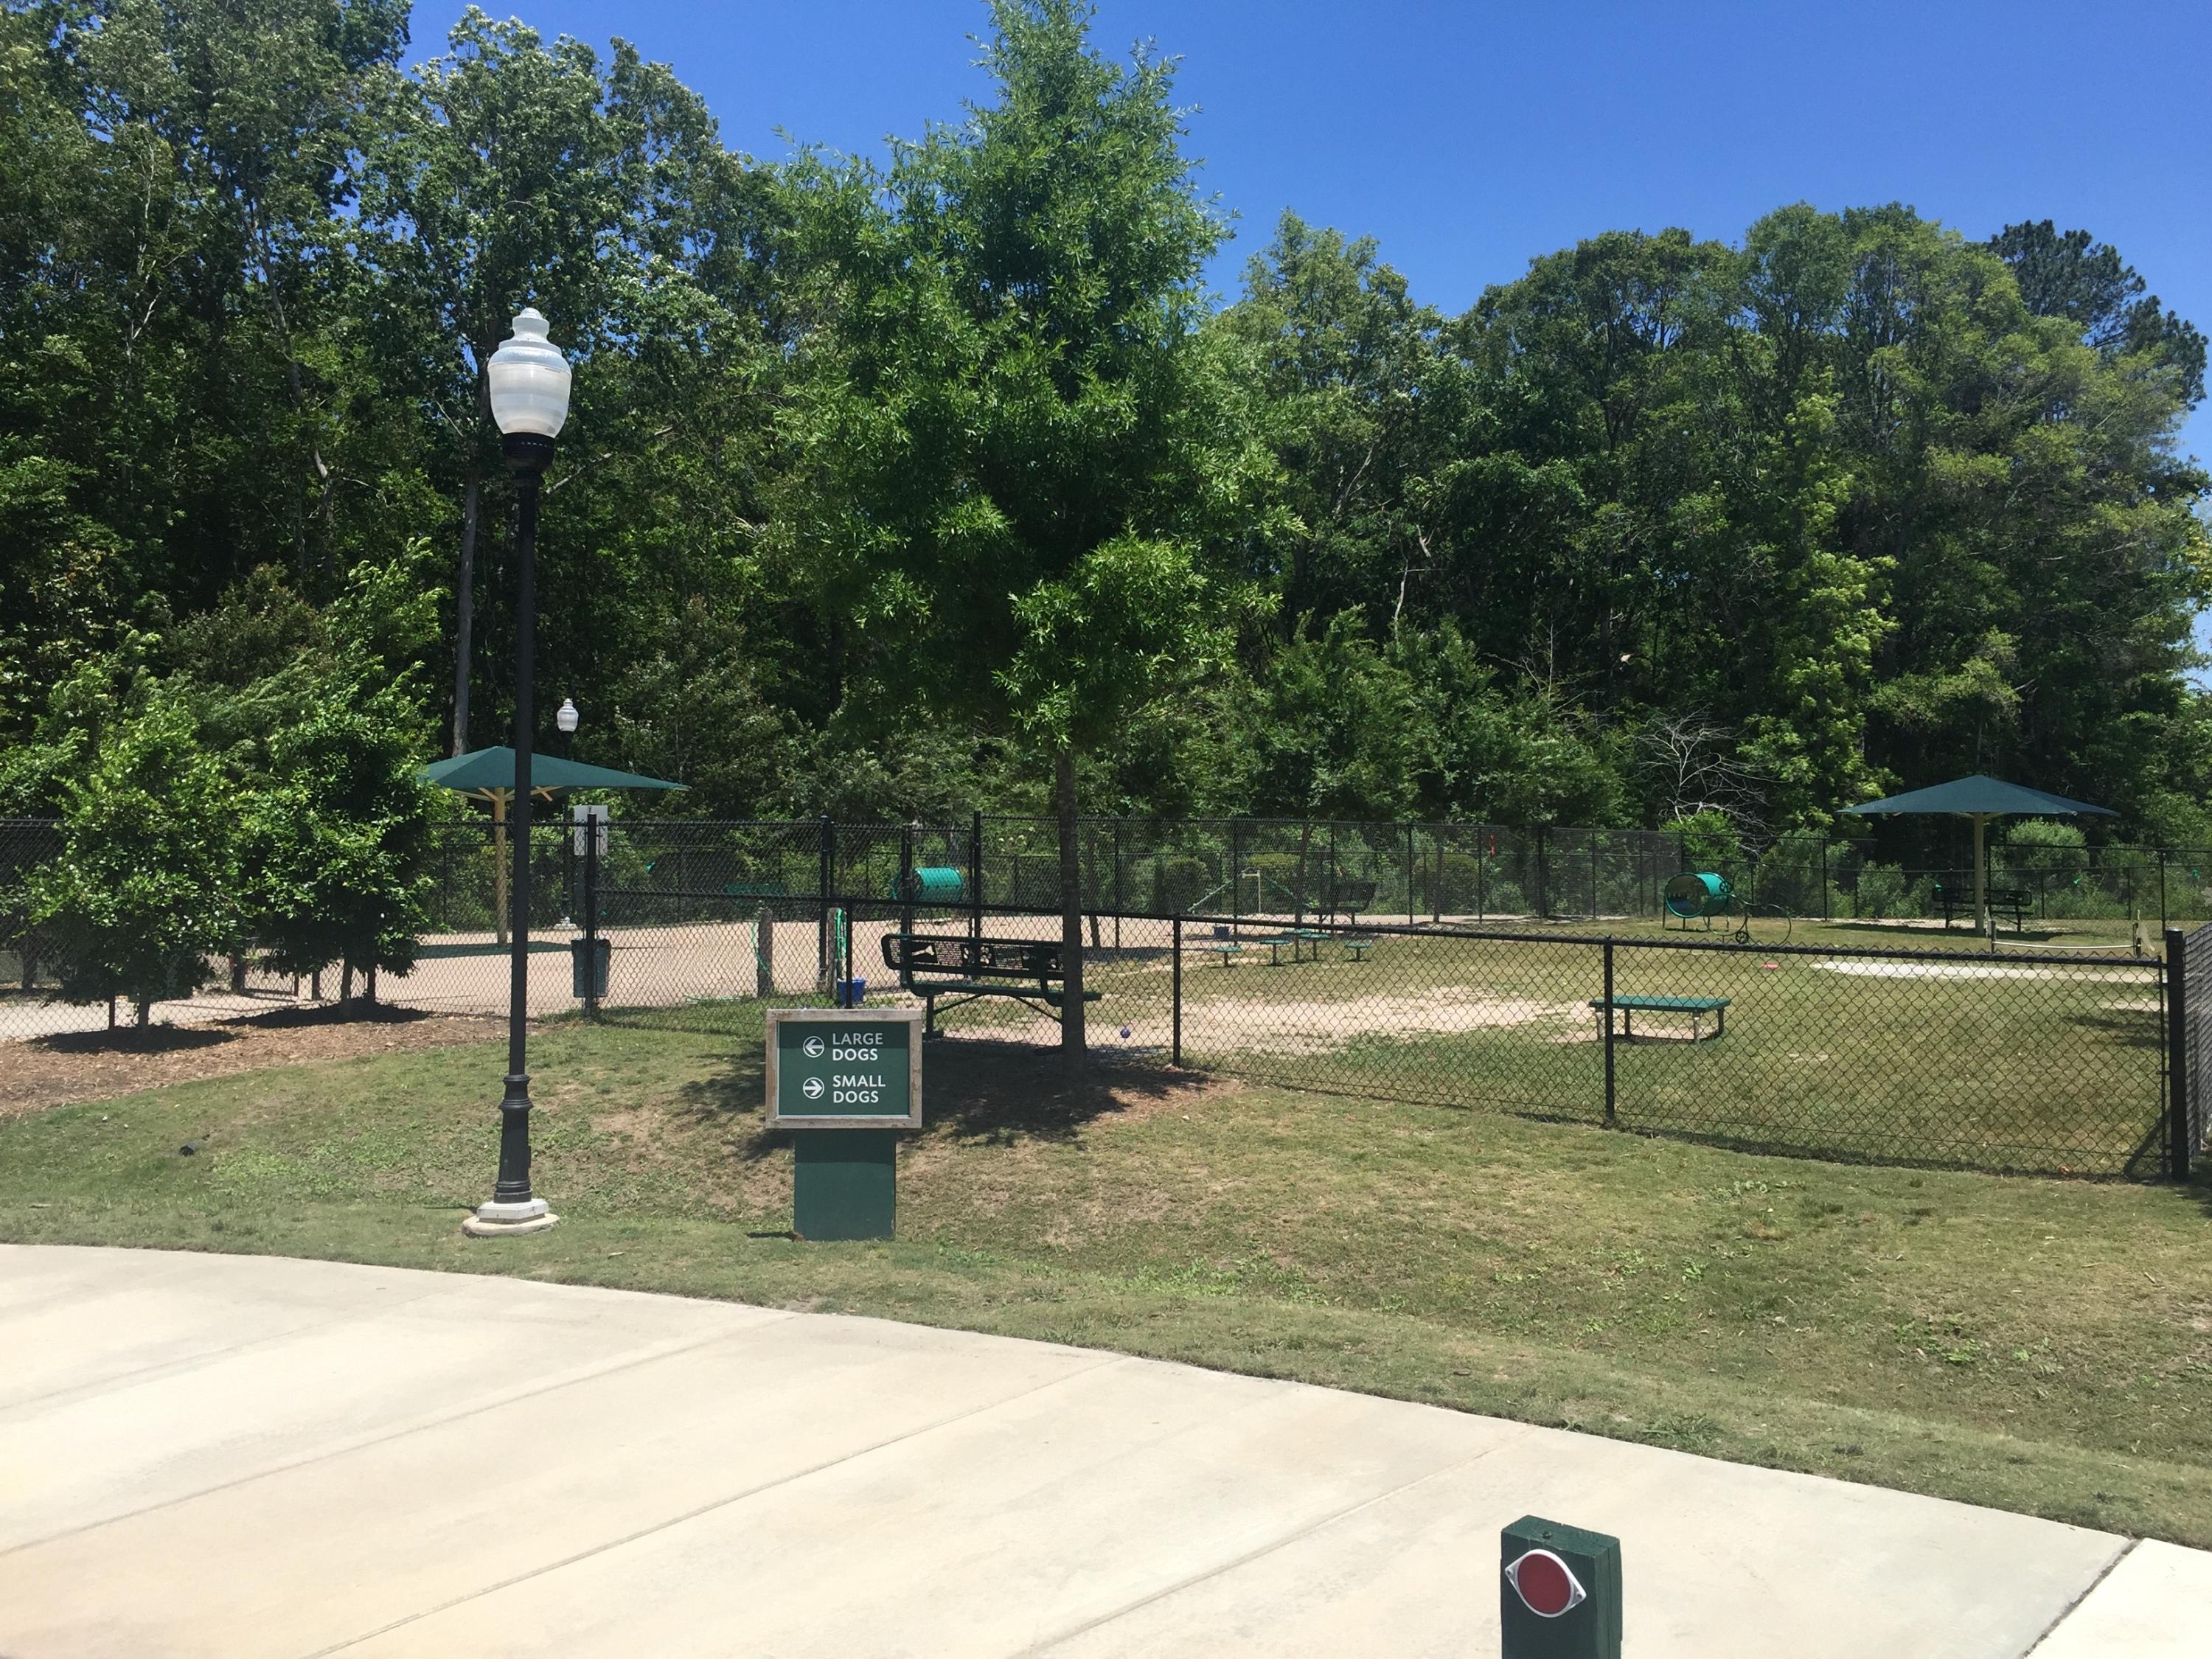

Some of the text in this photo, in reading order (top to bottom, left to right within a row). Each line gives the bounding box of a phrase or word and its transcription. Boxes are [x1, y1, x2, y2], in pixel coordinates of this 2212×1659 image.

[832, 1033, 883, 1045] LARGE
[832, 1048, 878, 1061] DOGS
[832, 1075, 886, 1088] SMALL
[833, 1091, 879, 1103] DOGS
